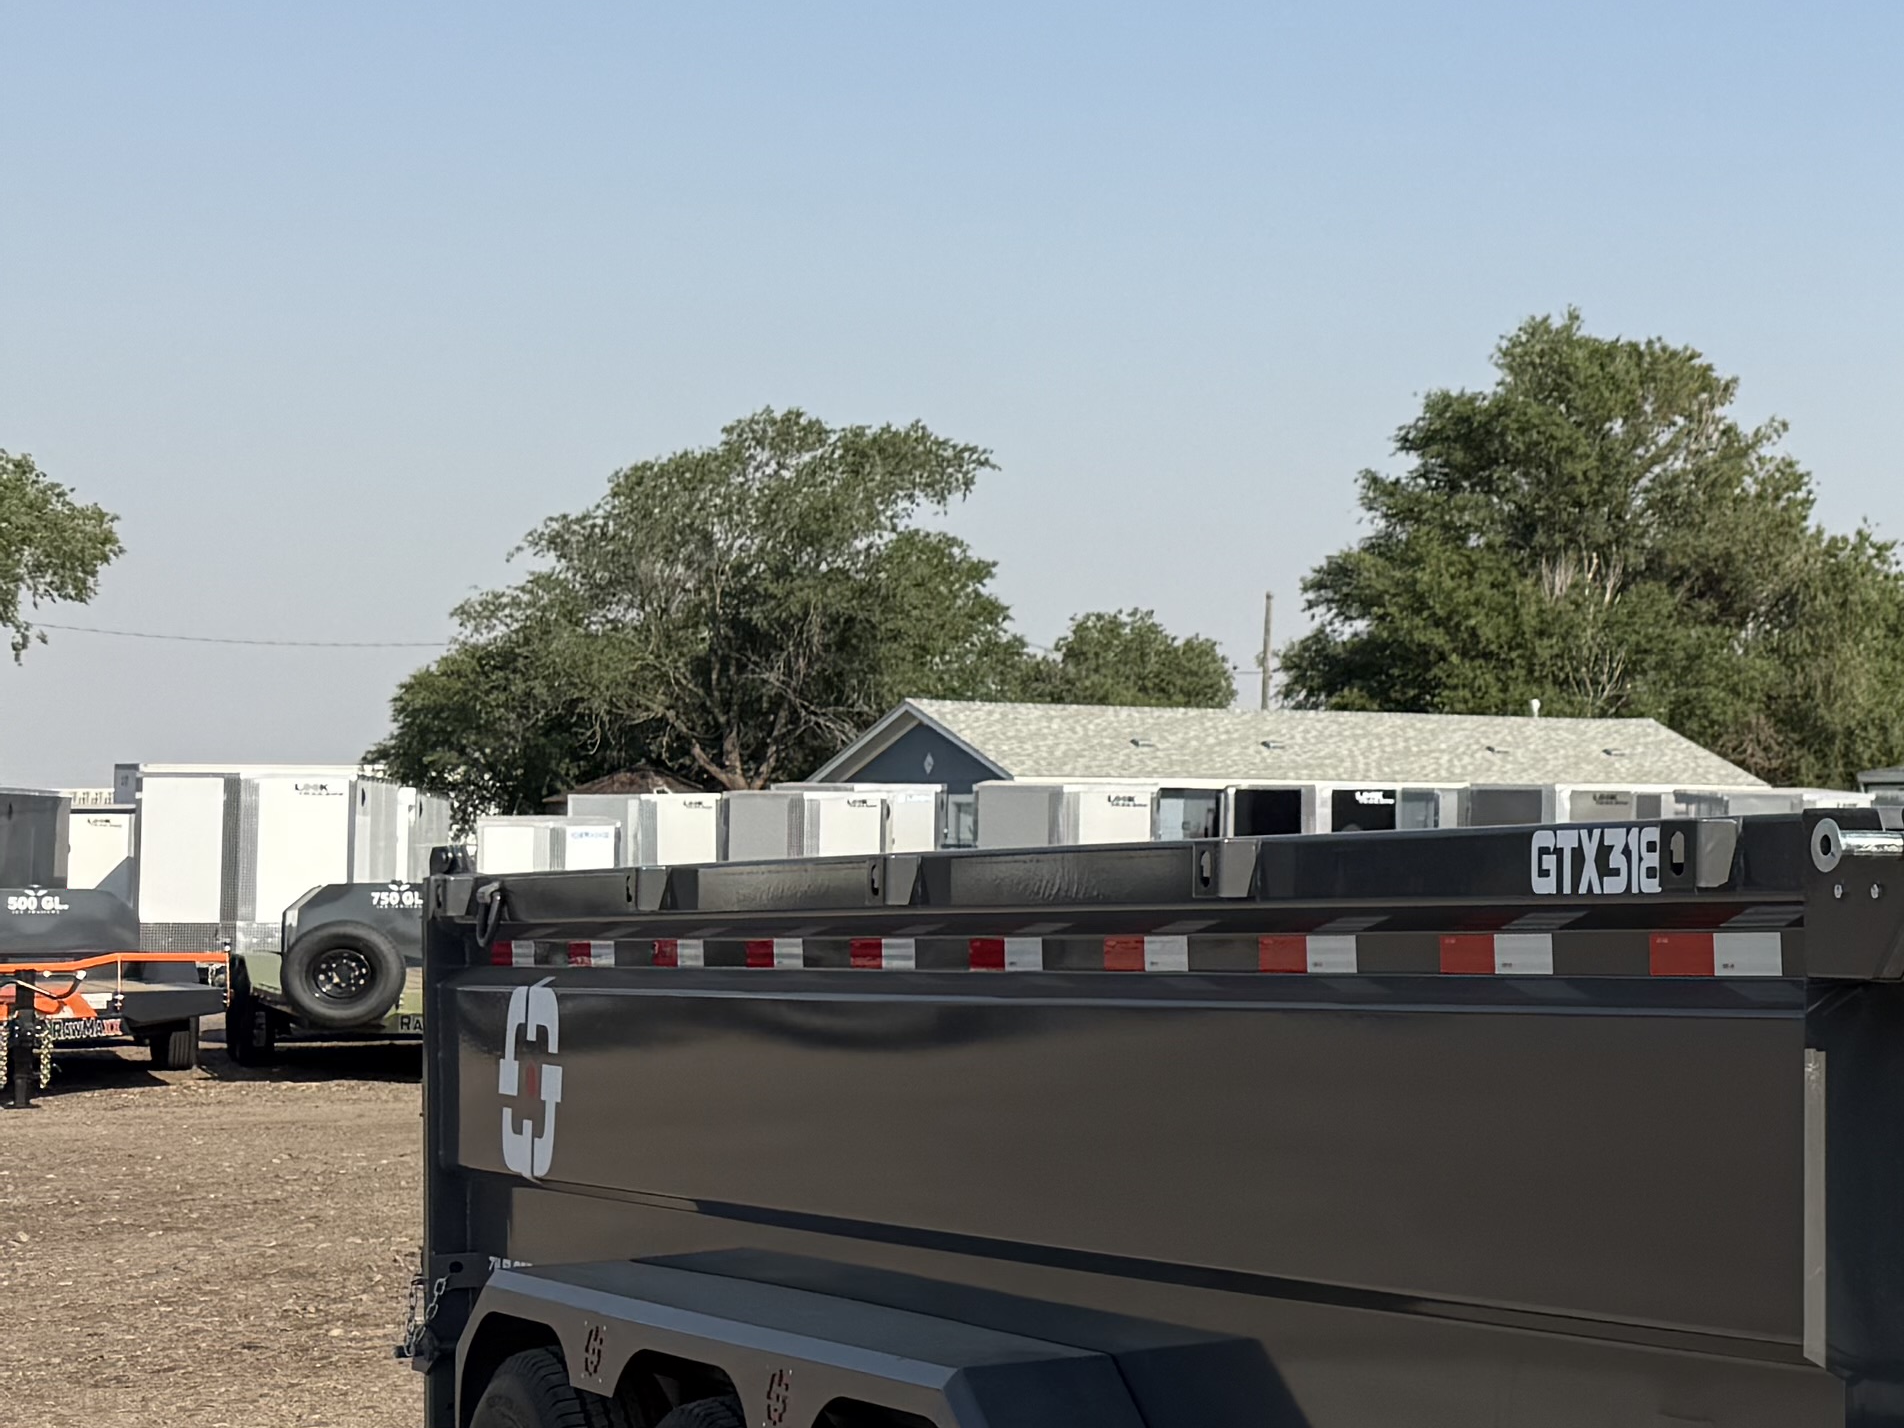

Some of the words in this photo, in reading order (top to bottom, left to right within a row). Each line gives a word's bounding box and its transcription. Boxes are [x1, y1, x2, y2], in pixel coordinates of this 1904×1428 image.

[1531, 826, 1662, 894] GTX318
[7, 896, 38, 911] 500
[370, 891, 400, 906] 750
